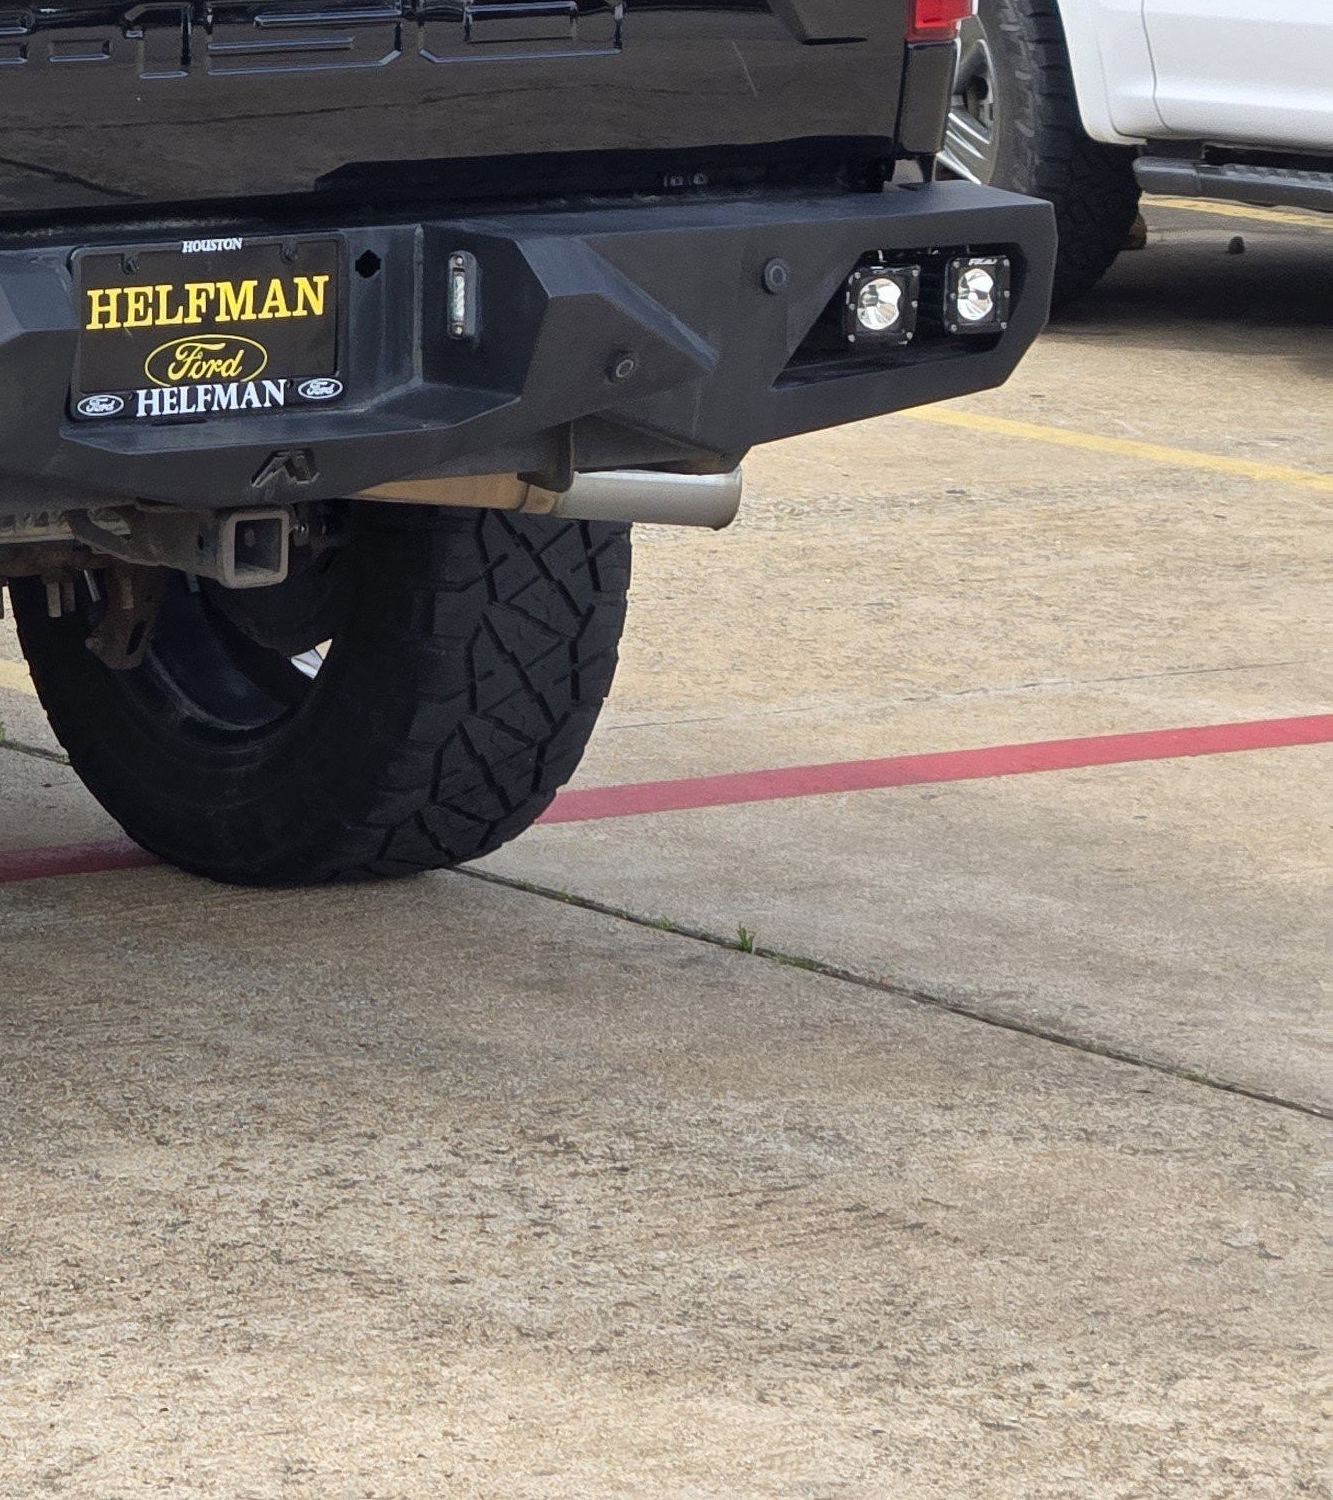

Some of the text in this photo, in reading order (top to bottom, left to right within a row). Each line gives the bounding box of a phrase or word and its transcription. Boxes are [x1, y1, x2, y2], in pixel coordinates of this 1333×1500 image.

[182, 237, 243, 254] HOUSTON
[85, 274, 330, 330] HELFMAN
[167, 342, 245, 381] Ford
[135, 378, 288, 417] HELFMAN
[306, 379, 336, 397] Ford
[84, 396, 116, 413] Ford
